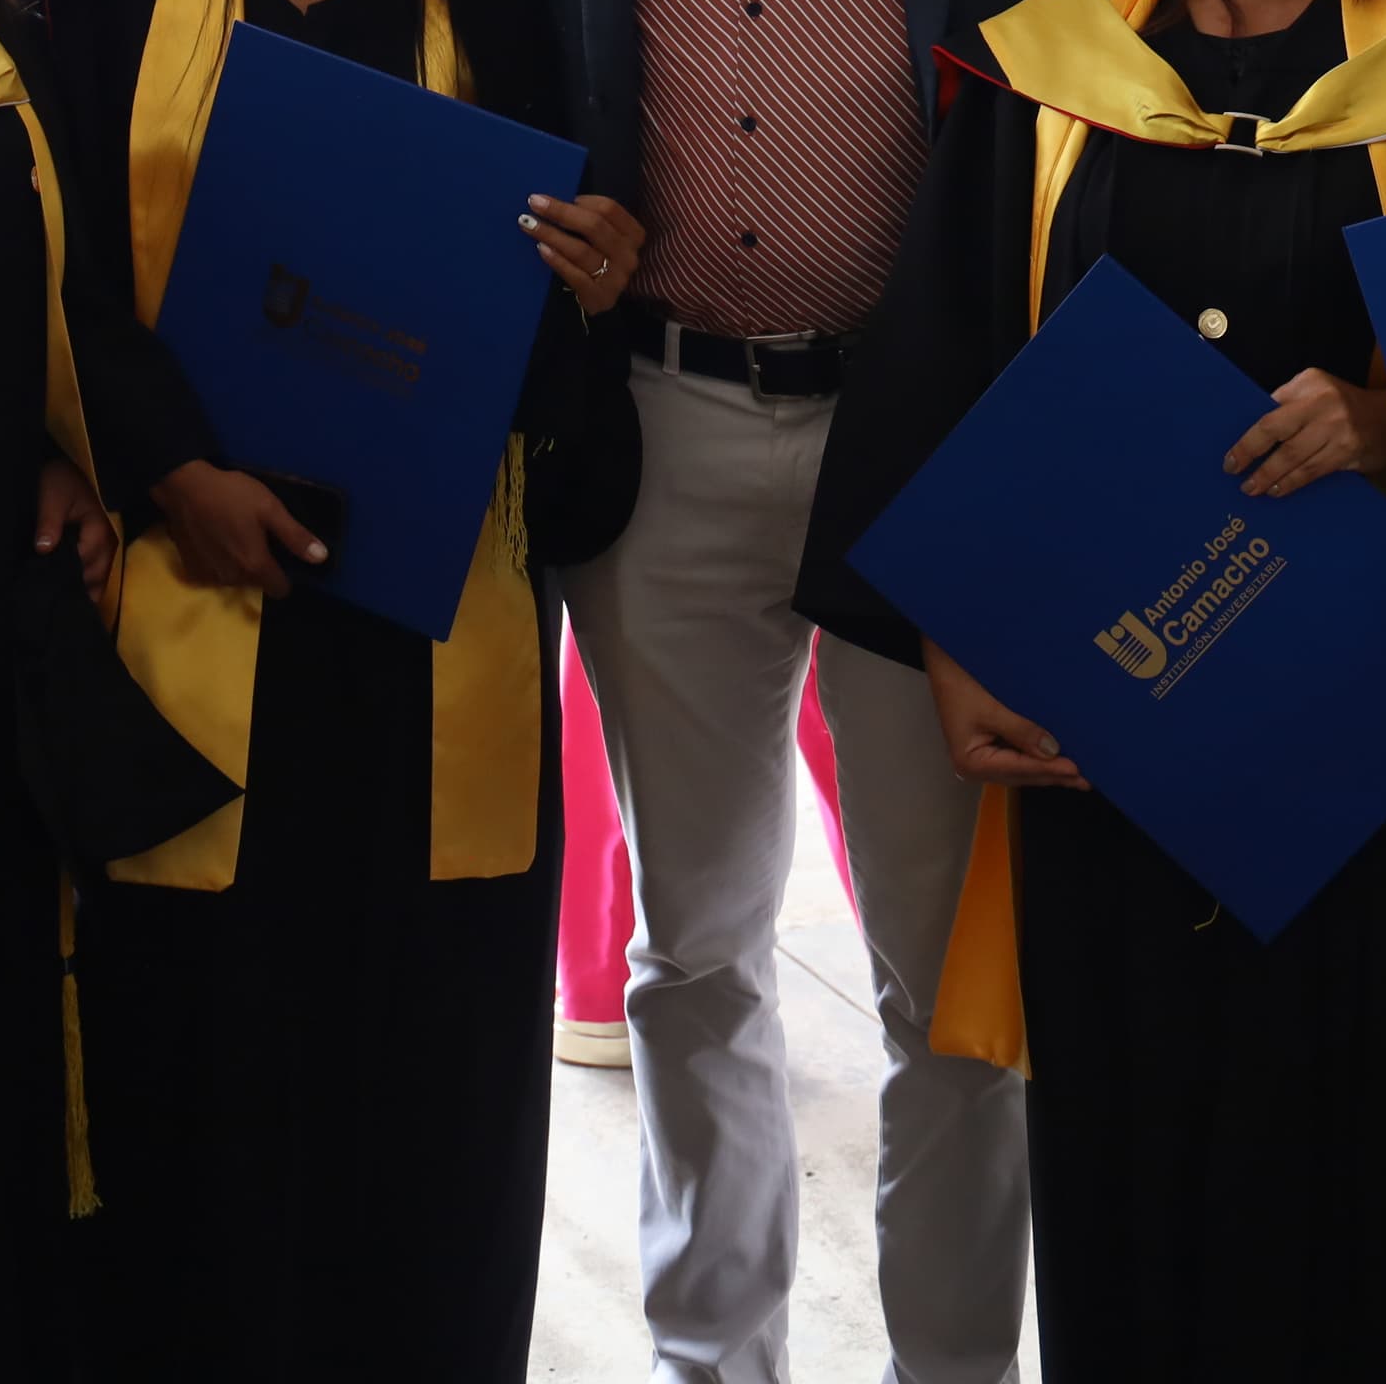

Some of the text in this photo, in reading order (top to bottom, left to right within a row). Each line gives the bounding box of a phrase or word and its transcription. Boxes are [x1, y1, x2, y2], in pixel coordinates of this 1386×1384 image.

[1143, 513, 1246, 627] Antonio José
[1150, 556, 1286, 698] INSTITUCIÓN UNIVERSITARIA
[1163, 537, 1270, 647] Camacho
